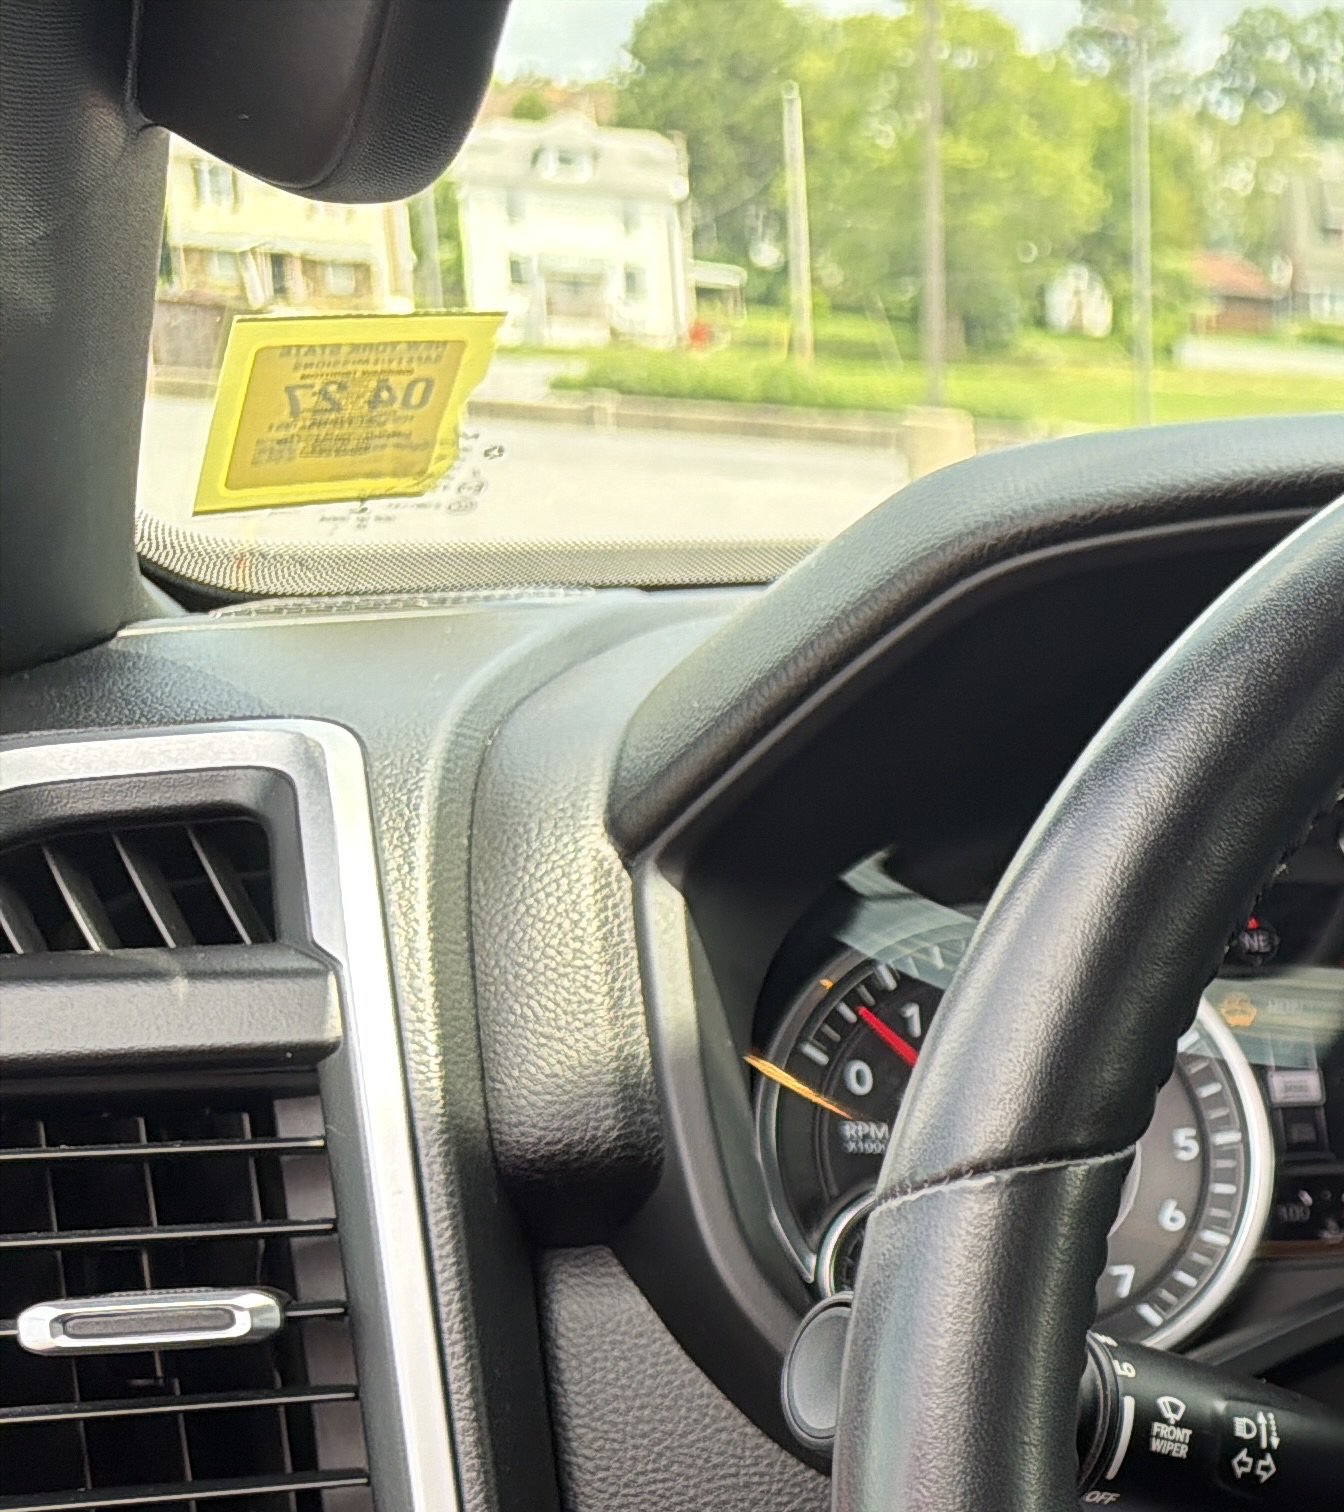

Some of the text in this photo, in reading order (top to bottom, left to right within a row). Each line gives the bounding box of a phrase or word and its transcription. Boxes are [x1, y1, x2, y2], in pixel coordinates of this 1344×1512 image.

[901, 1002, 921, 1038] 1
[844, 1059, 873, 1095] 0
[839, 1120, 889, 1140] RPM
[1173, 1127, 1199, 1161] 5
[1159, 1199, 1186, 1232] 6
[1108, 1264, 1135, 1298] 7
[1150, 1437, 1190, 1459] WIPER
[1152, 1422, 1193, 1443] FRONT
[1085, 1490, 1120, 1504] OFF
